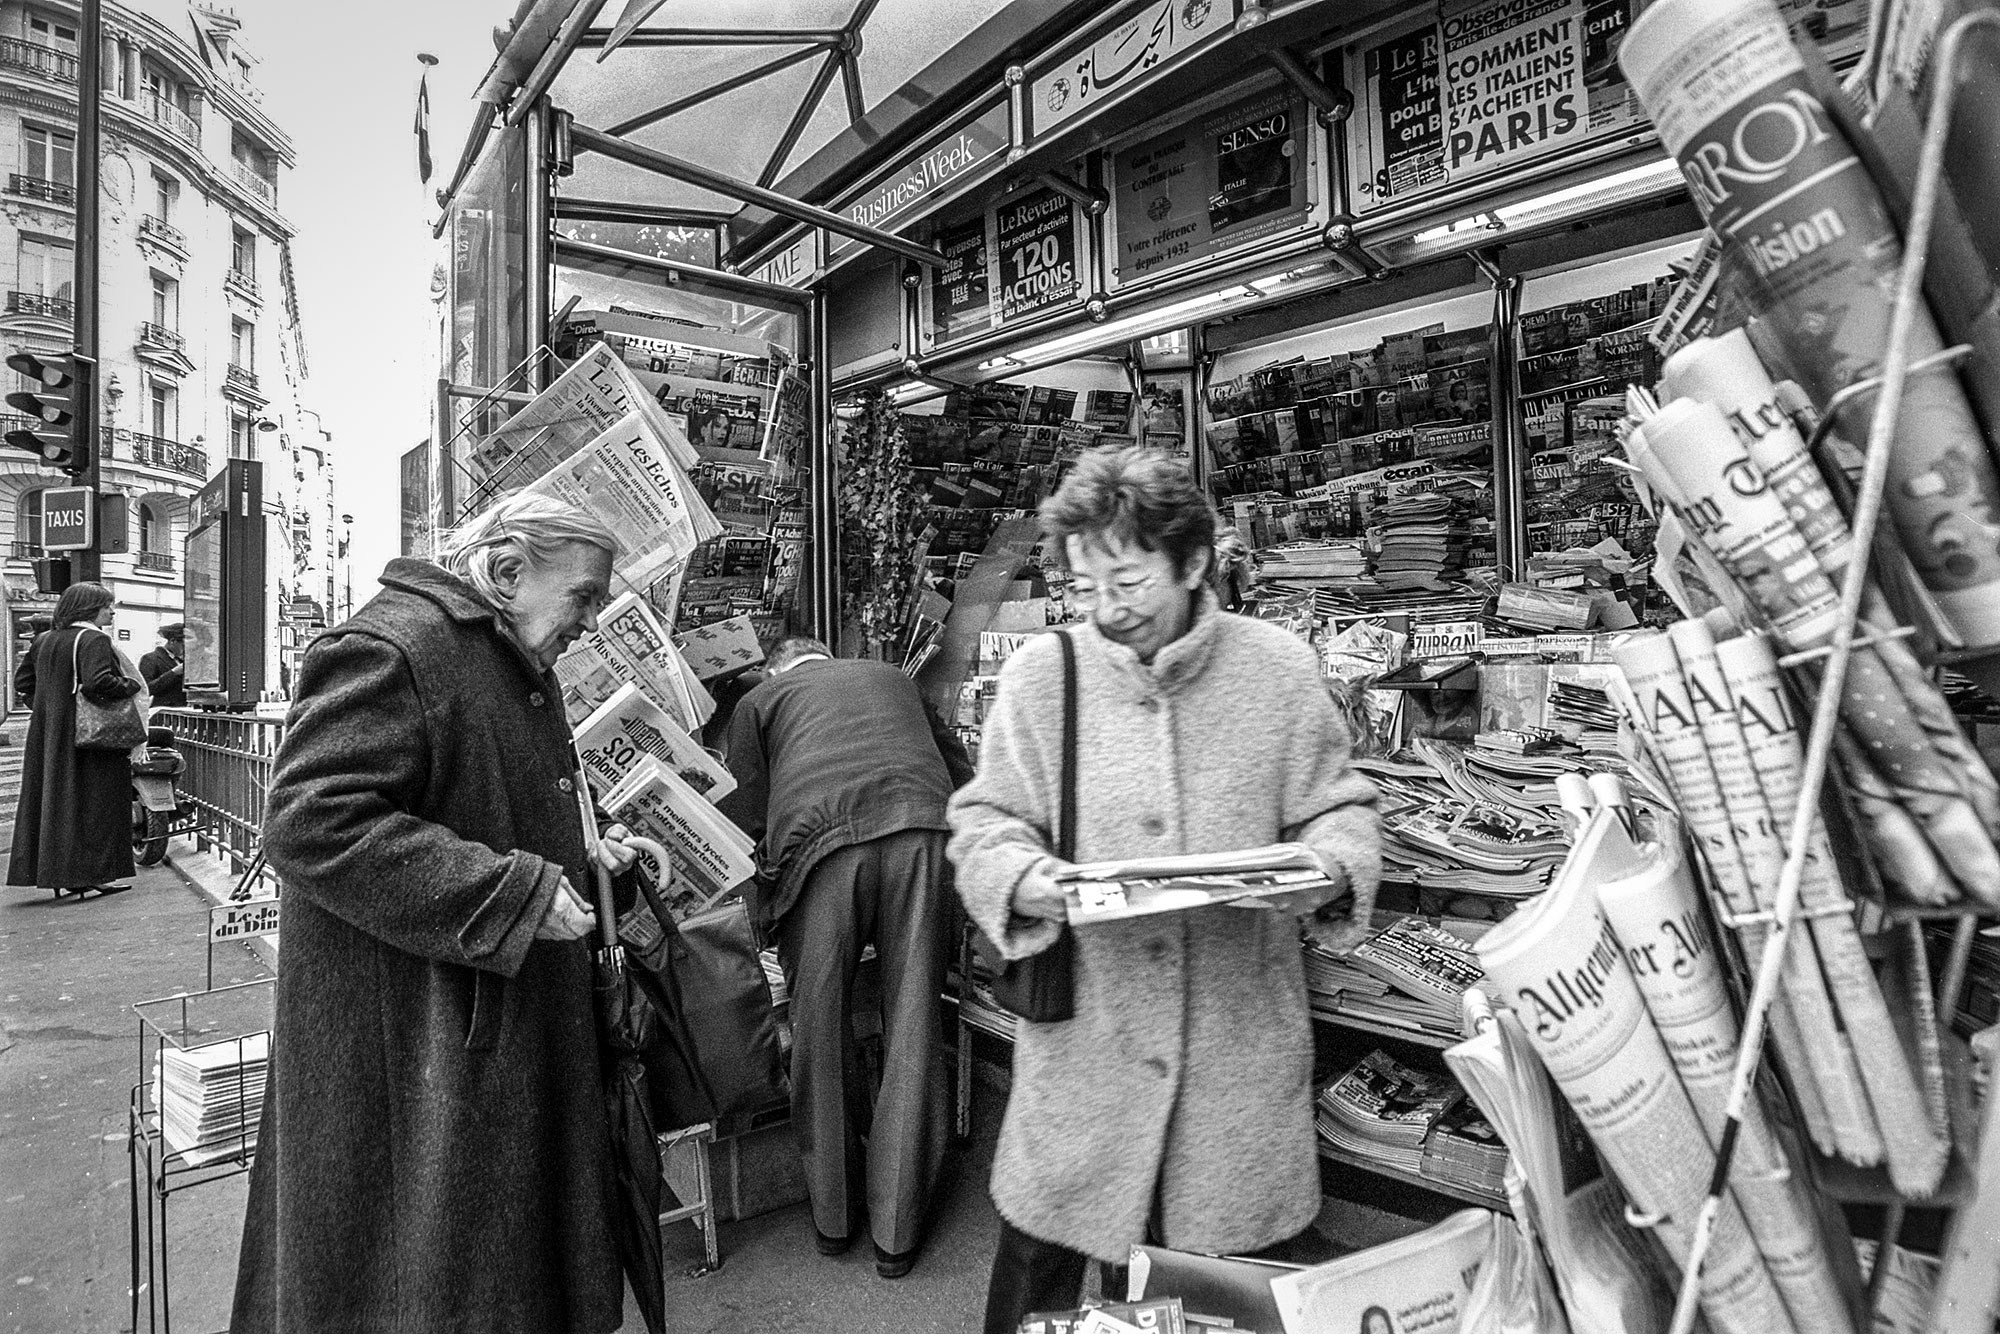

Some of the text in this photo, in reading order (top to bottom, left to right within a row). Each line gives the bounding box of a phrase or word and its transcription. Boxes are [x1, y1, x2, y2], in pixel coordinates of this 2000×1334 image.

[1391, 49, 1417, 73] Le
[1447, 17, 1573, 84] COMMENT
[1447, 45, 1574, 109] LES ITALIENS
[1390, 96, 1435, 130] pour
[1449, 69, 1576, 131] S'ACHETENT
[1221, 115, 1286, 154] SENSO
[1401, 122, 1425, 141] en
[1451, 94, 1578, 169] PARIS
[852, 135, 974, 229] BusinessWeek
[1225, 178, 1248, 192] ITALIE
[1000, 194, 1068, 235] Le Revenu
[1000, 212, 1069, 251] Par secteur d'activité
[945, 234, 982, 260] oyeuses
[1153, 221, 1197, 246] référence
[1744, 208, 1847, 277] ision
[1011, 234, 1059, 279] 120
[1135, 241, 1190, 271] depuis 1932
[941, 269, 963, 285] avec
[1003, 262, 1073, 306] ACTIONS
[1004, 306, 1016, 319] au
[1016, 297, 1040, 315] banc
[588, 369, 613, 395] La
[1430, 424, 1491, 447] BON VOYAGE
[602, 442, 611, 453] La
[610, 451, 634, 479] reprise
[625, 435, 680, 509] Les Echos
[972, 459, 984, 469] de
[1347, 480, 1381, 492] Tribune
[47, 510, 84, 527] TAXIS
[612, 616, 651, 656] Soir
[626, 607, 661, 649] France
[589, 634, 612, 660] Plus
[639, 797, 651, 810] de
[651, 807, 677, 833] votre
[675, 830, 731, 883] département
[646, 790, 661, 806] Les
[663, 805, 702, 845] meilleurs
[702, 842, 730, 871] lycées
[216, 925, 239, 937] du
[228, 912, 252, 923] Le
